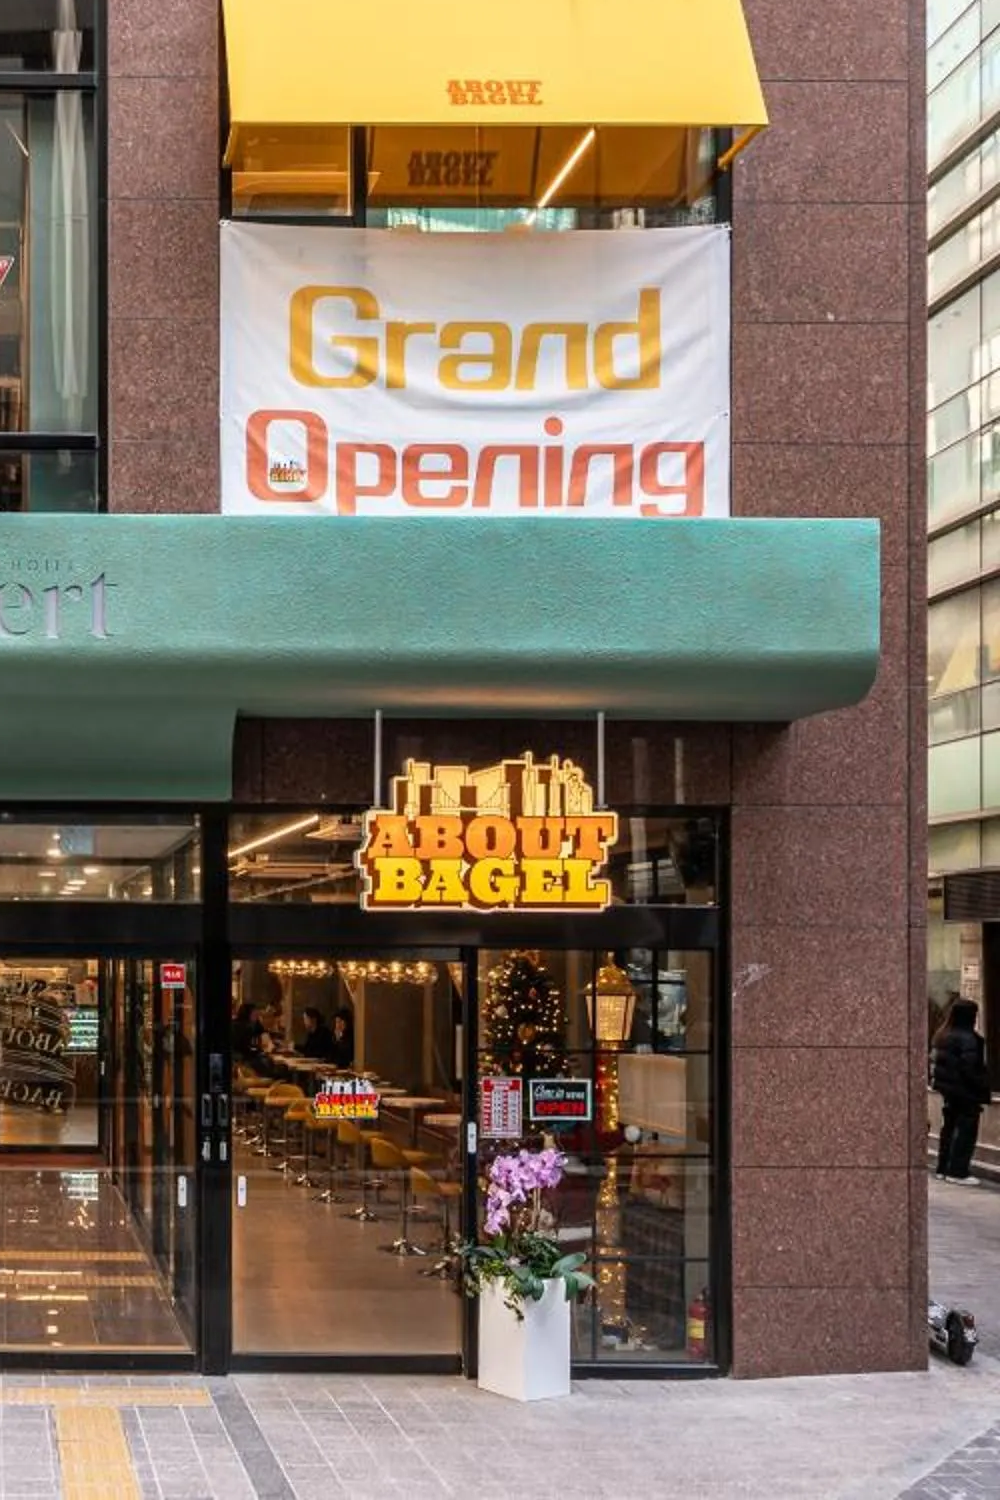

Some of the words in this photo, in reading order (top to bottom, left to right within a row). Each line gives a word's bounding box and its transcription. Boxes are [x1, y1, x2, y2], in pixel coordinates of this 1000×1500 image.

[446, 80, 543, 93] ABOUT
[449, 92, 543, 105] BAGEL
[289, 285, 662, 391] Grand
[246, 409, 706, 517] Opening
[367, 815, 614, 859] ABOUT
[373, 857, 608, 904] BAGEL
[535, 1102, 585, 1114] OPEN
